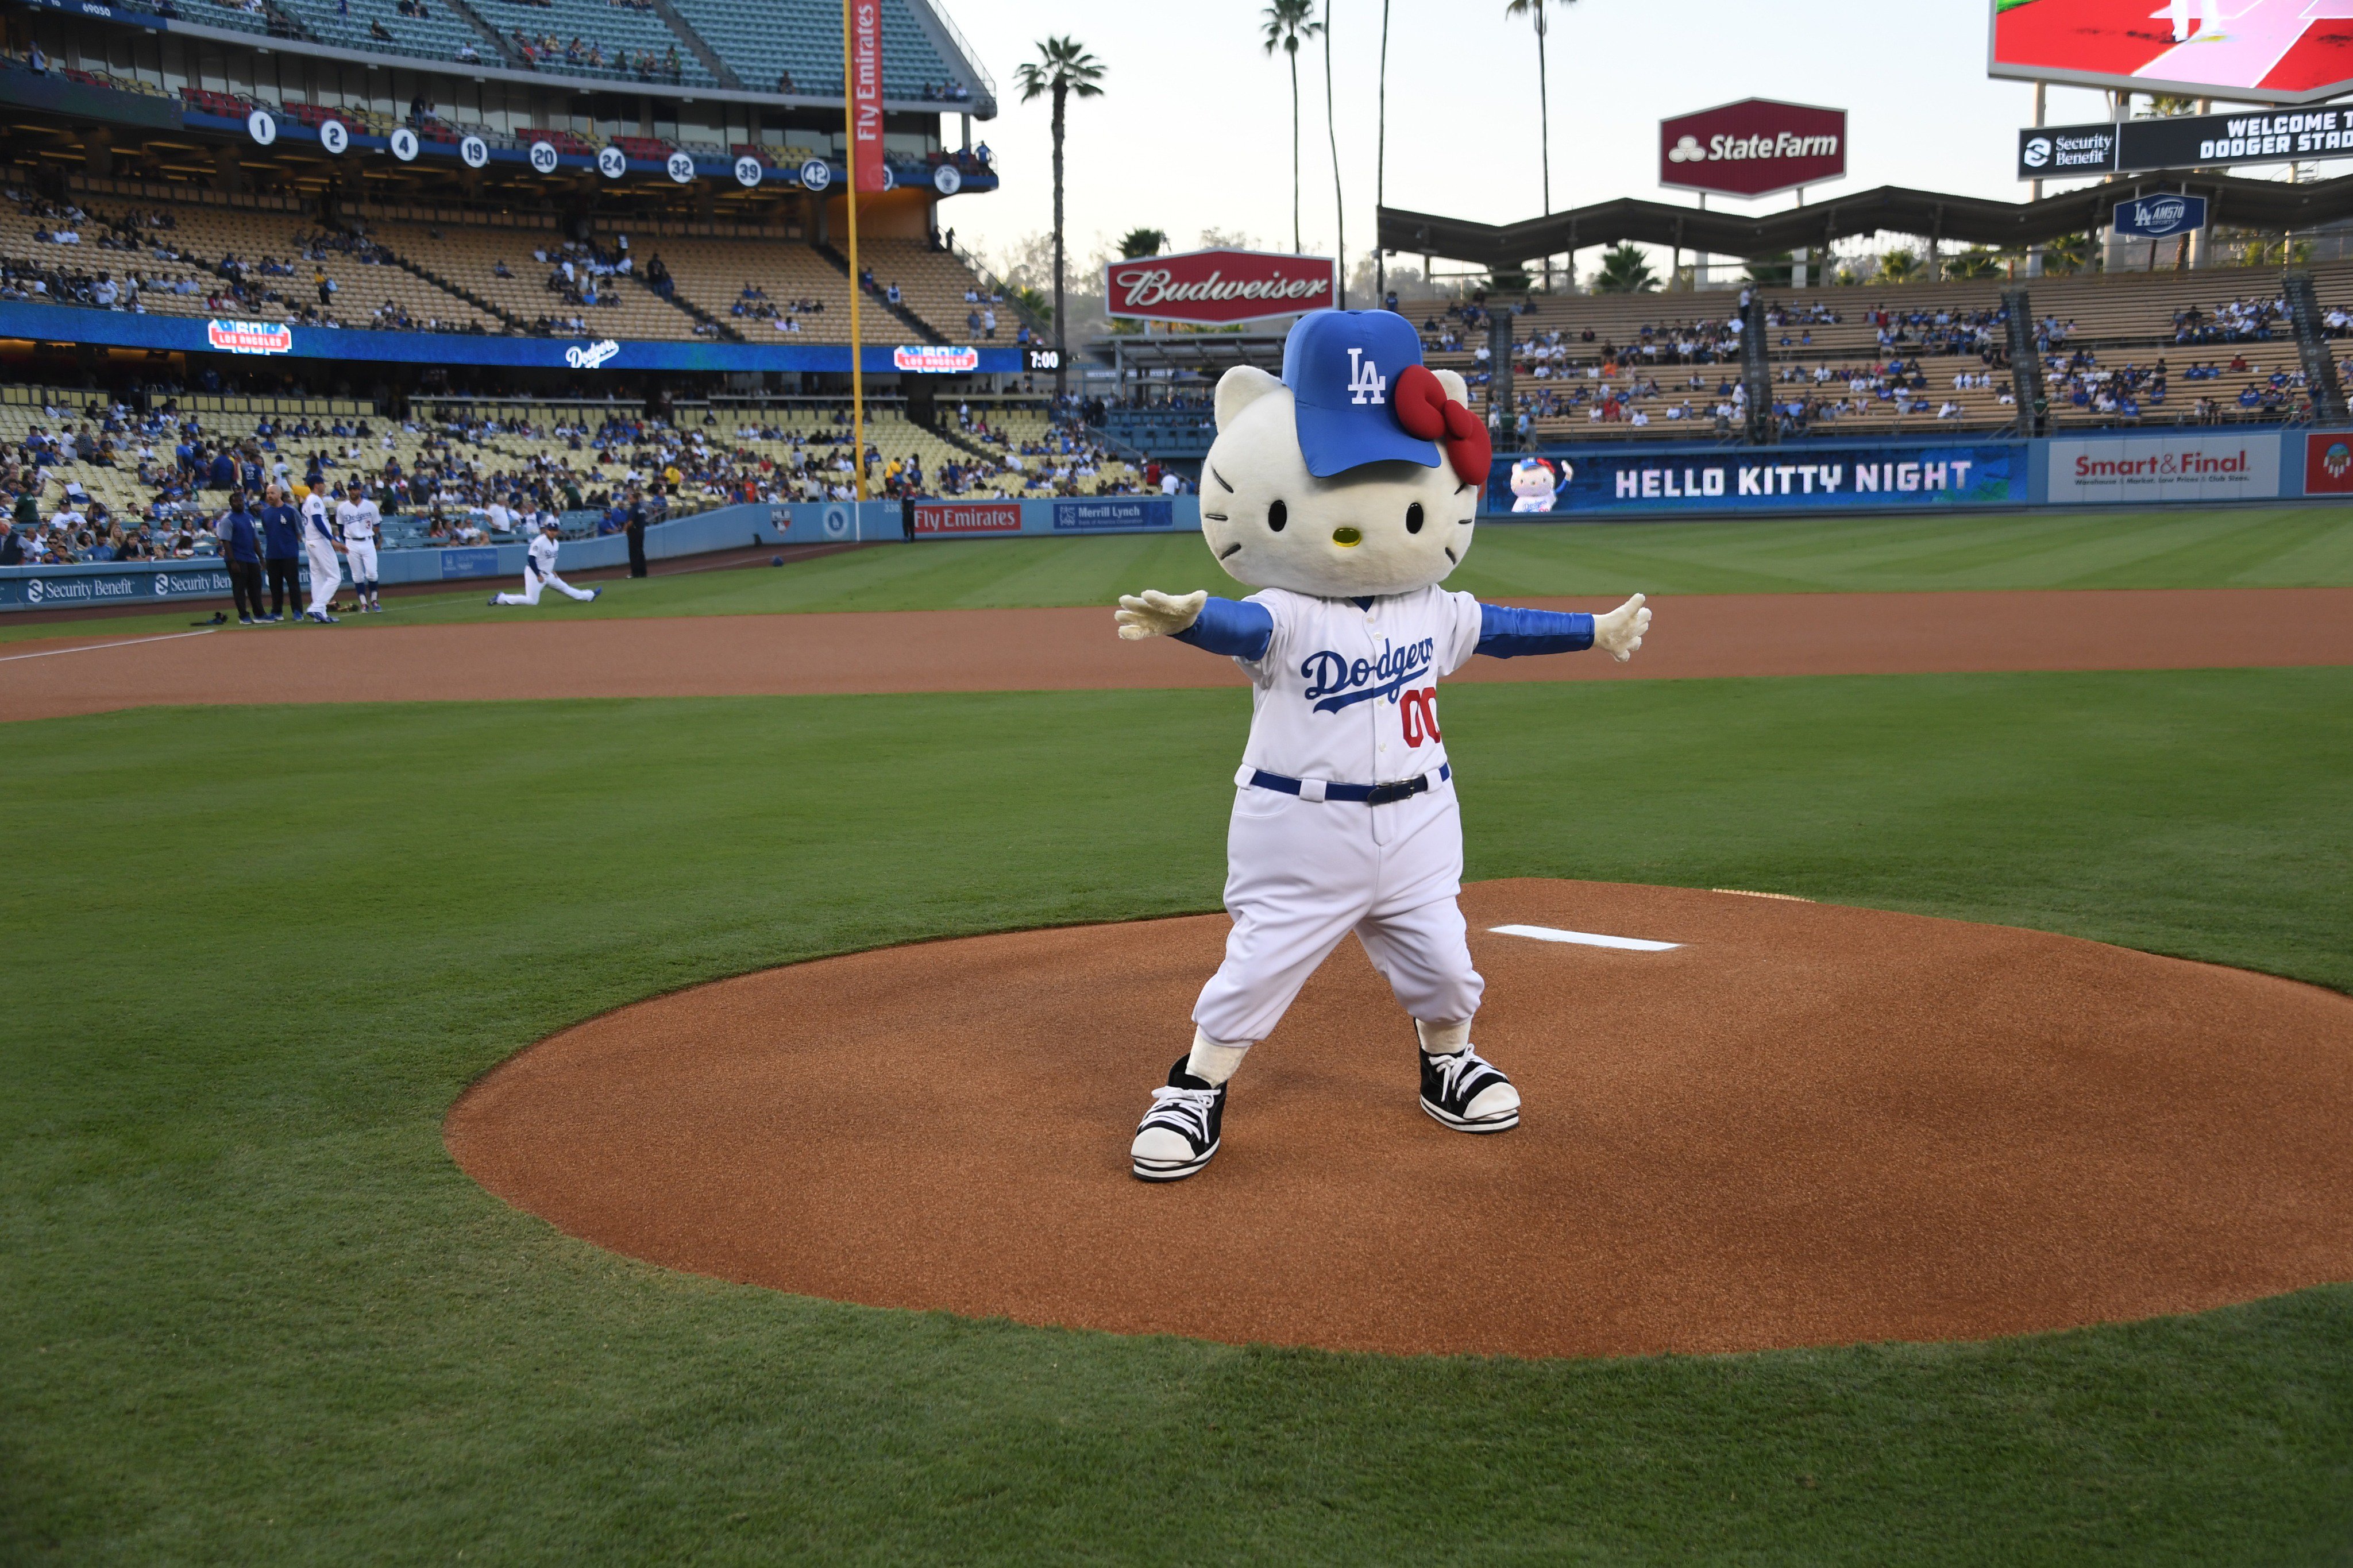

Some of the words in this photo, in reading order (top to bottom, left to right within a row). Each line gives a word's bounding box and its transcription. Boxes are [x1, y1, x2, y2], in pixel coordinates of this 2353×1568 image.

[82, 3, 111, 17] 69050
[855, 4, 875, 100] Emirates
[259, 119, 267, 137] 1
[857, 103, 880, 141] Fly
[2227, 111, 2337, 138] WELCOME
[330, 128, 340, 147] 2
[399, 136, 409, 155] 4
[2055, 133, 2113, 151] Security
[2200, 134, 2292, 159] DODGER
[466, 142, 483, 161] 19
[534, 149, 554, 166] 20
[2055, 148, 2105, 166] Benefit
[603, 155, 623, 172] 24
[671, 160, 690, 177] 32
[739, 164, 758, 180] 39
[805, 167, 828, 184] 42
[2134, 202, 2152, 227] LA
[1116, 269, 1328, 307] Budweiser
[219, 334, 237, 344] LOS
[239, 335, 282, 347] ANGELES
[565, 338, 619, 368] Dodgers
[1030, 351, 1059, 368] 7:00
[1347, 348, 1386, 404] LA
[1616, 468, 1724, 498] HELLO
[1739, 464, 1842, 496] KITTY
[1856, 461, 1972, 492] NIGHT
[884, 504, 900, 513] 330
[1078, 506, 1110, 517] Merrill
[1112, 505, 1140, 518] Lynch
[915, 510, 940, 531] Fly
[943, 508, 1016, 527] Emirates
[46, 580, 92, 600] Security
[94, 578, 133, 596] Benefit
[170, 574, 211, 593] Security
